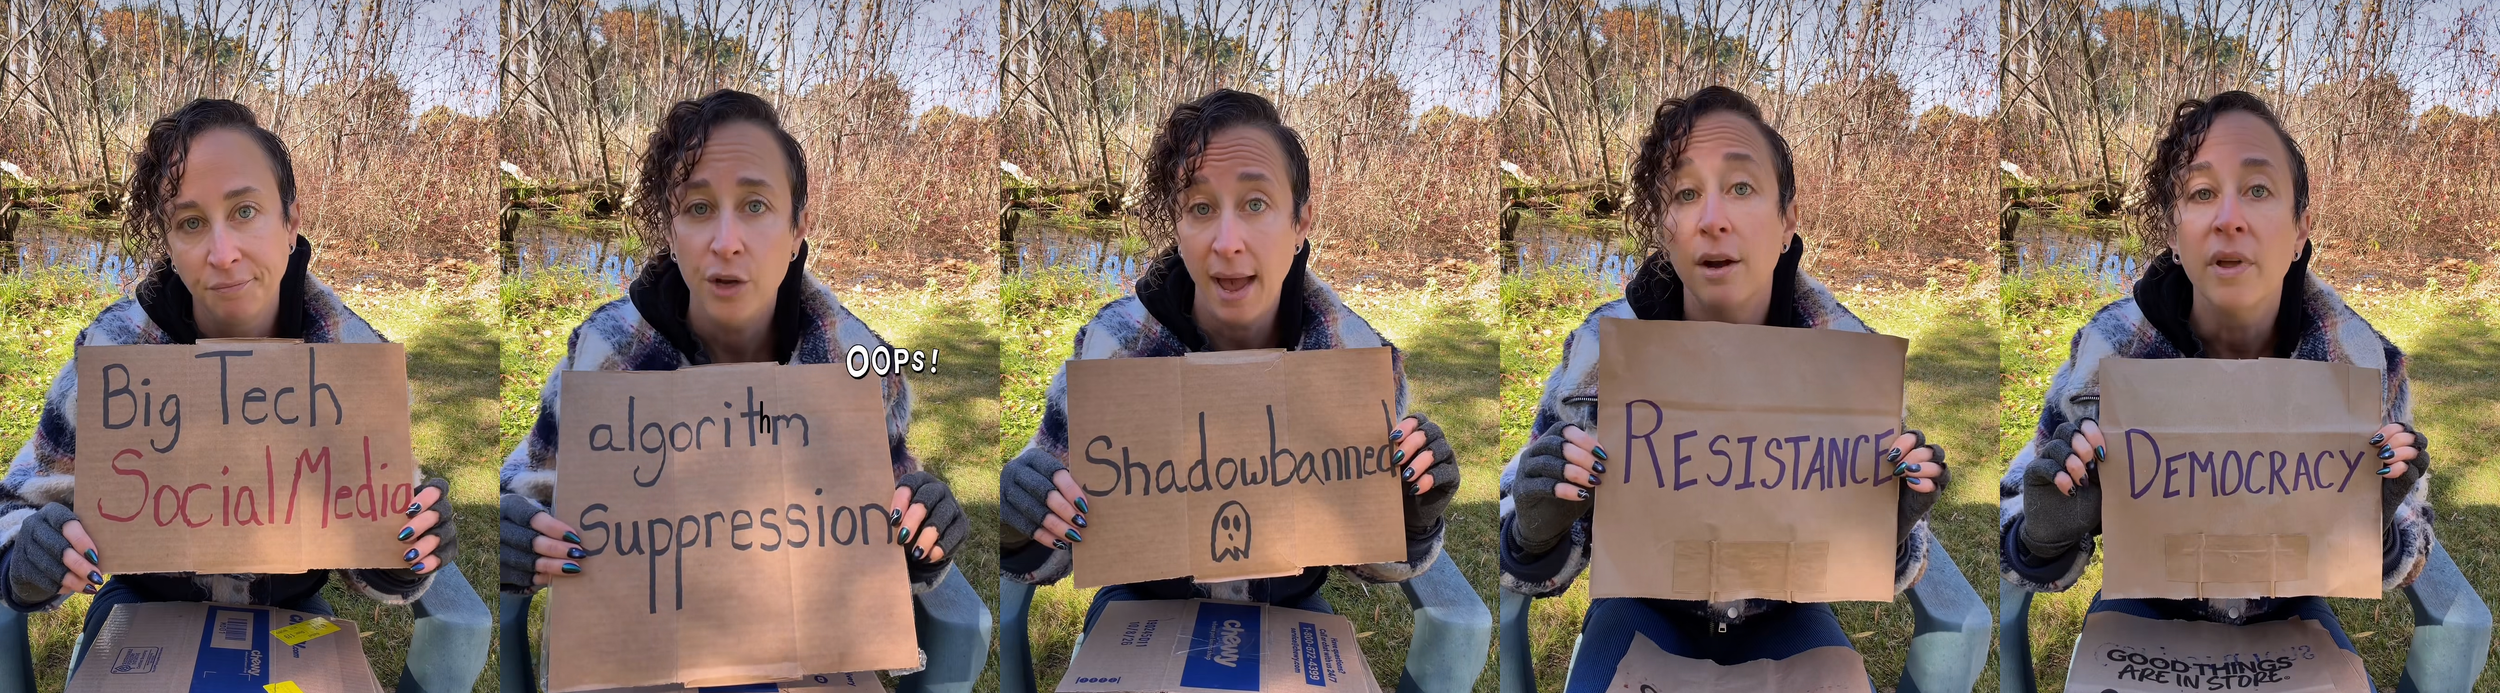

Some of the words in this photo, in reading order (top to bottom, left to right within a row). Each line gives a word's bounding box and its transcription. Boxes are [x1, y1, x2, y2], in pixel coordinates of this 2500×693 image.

[102, 363, 182, 454] Big
[194, 347, 343, 427] Tech
[589, 386, 809, 487] algorithm
[1082, 399, 1397, 497] Shadowbanned
[1623, 399, 1895, 492] RESISTANCE
[2125, 428, 2365, 500] DEMOCRACY
[97, 448, 275, 528] Social
[284, 436, 412, 529] Media
[1214, 619, 1245, 668] chewy
[1303, 627, 1320, 681] 1-800-672-4399
[1331, 649, 1346, 674] questions?
[2107, 649, 2190, 673] GOOD
[2193, 656, 2293, 676] THINGS
[1327, 668, 1337, 683] 24/7
[2118, 664, 2170, 683] ARE
[2176, 673, 2200, 690] IN
